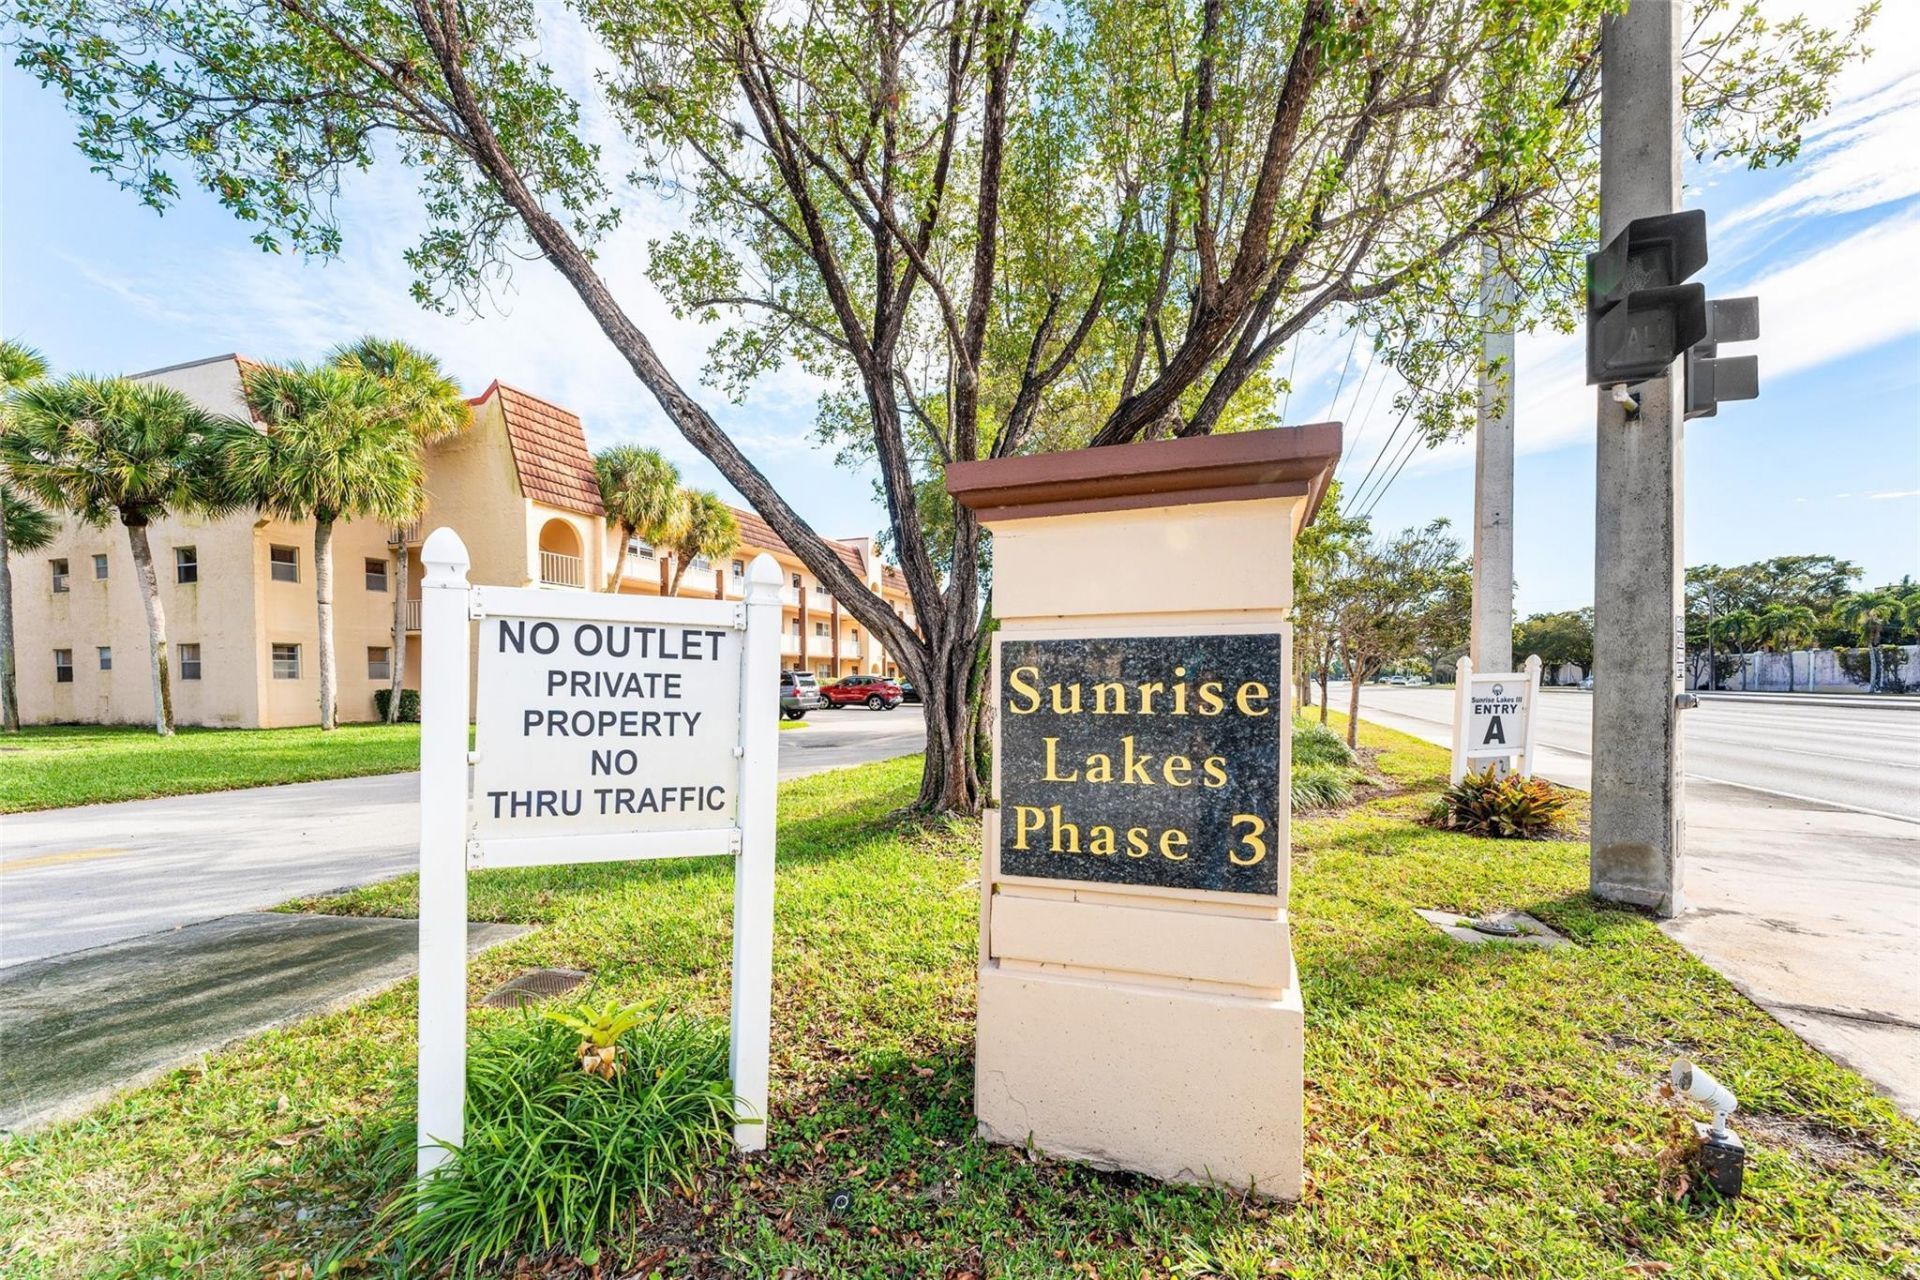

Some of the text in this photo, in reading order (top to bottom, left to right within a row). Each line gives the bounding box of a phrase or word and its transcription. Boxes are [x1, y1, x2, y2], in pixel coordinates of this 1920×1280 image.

[498, 620, 726, 661] NO OUTLET
[547, 670, 682, 699] PRIVATE
[1009, 666, 1269, 717] Sunrise
[523, 710, 701, 737] PROPERTY
[1474, 704, 1518, 715] ENTRY
[1482, 715, 1506, 745] A
[591, 749, 638, 776] NO
[1041, 735, 1228, 789] Lakes
[487, 785, 726, 819] THRU TRAFFIC
[1013, 805, 1267, 867] Phase 3
